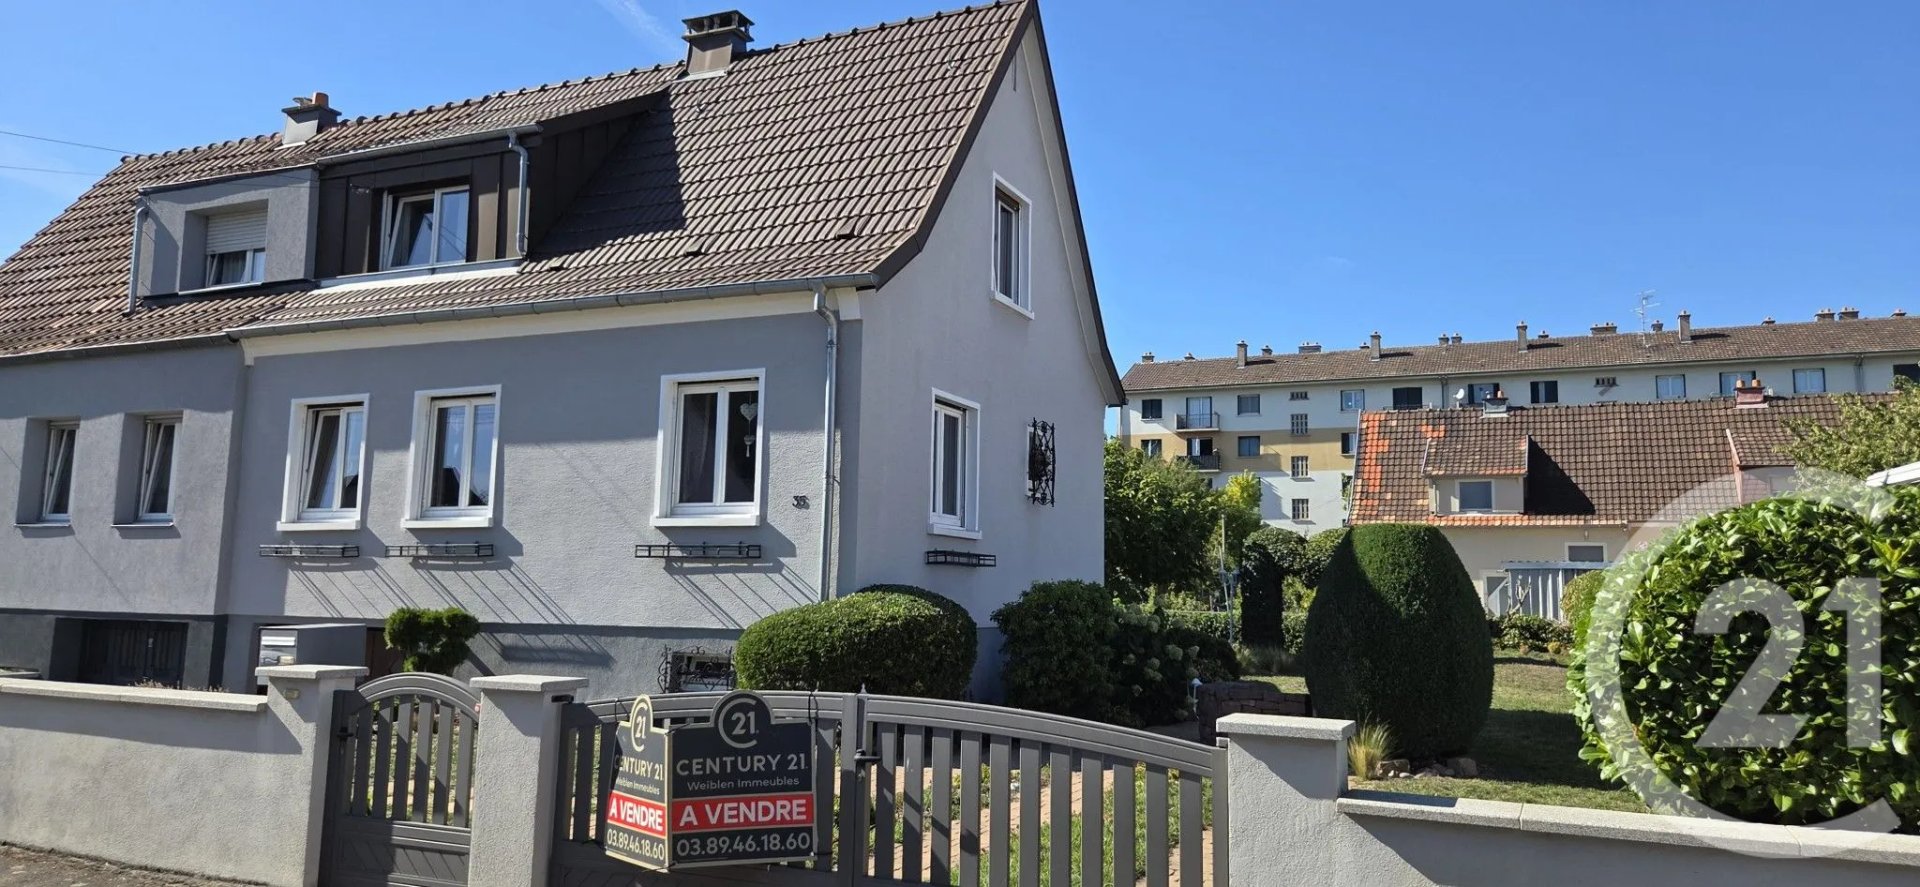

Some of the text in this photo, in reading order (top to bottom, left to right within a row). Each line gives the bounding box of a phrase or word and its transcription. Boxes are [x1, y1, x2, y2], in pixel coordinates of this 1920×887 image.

[676, 753, 806, 776] CENTURY 21
[687, 776, 800, 791] Weiblen Immeubles
[609, 797, 664, 831] A VENDRE
[679, 799, 807, 827] A VENDRE
[607, 828, 665, 861] 03.89.46.18.60
[676, 832, 810, 856] 03.89.46.18.60
